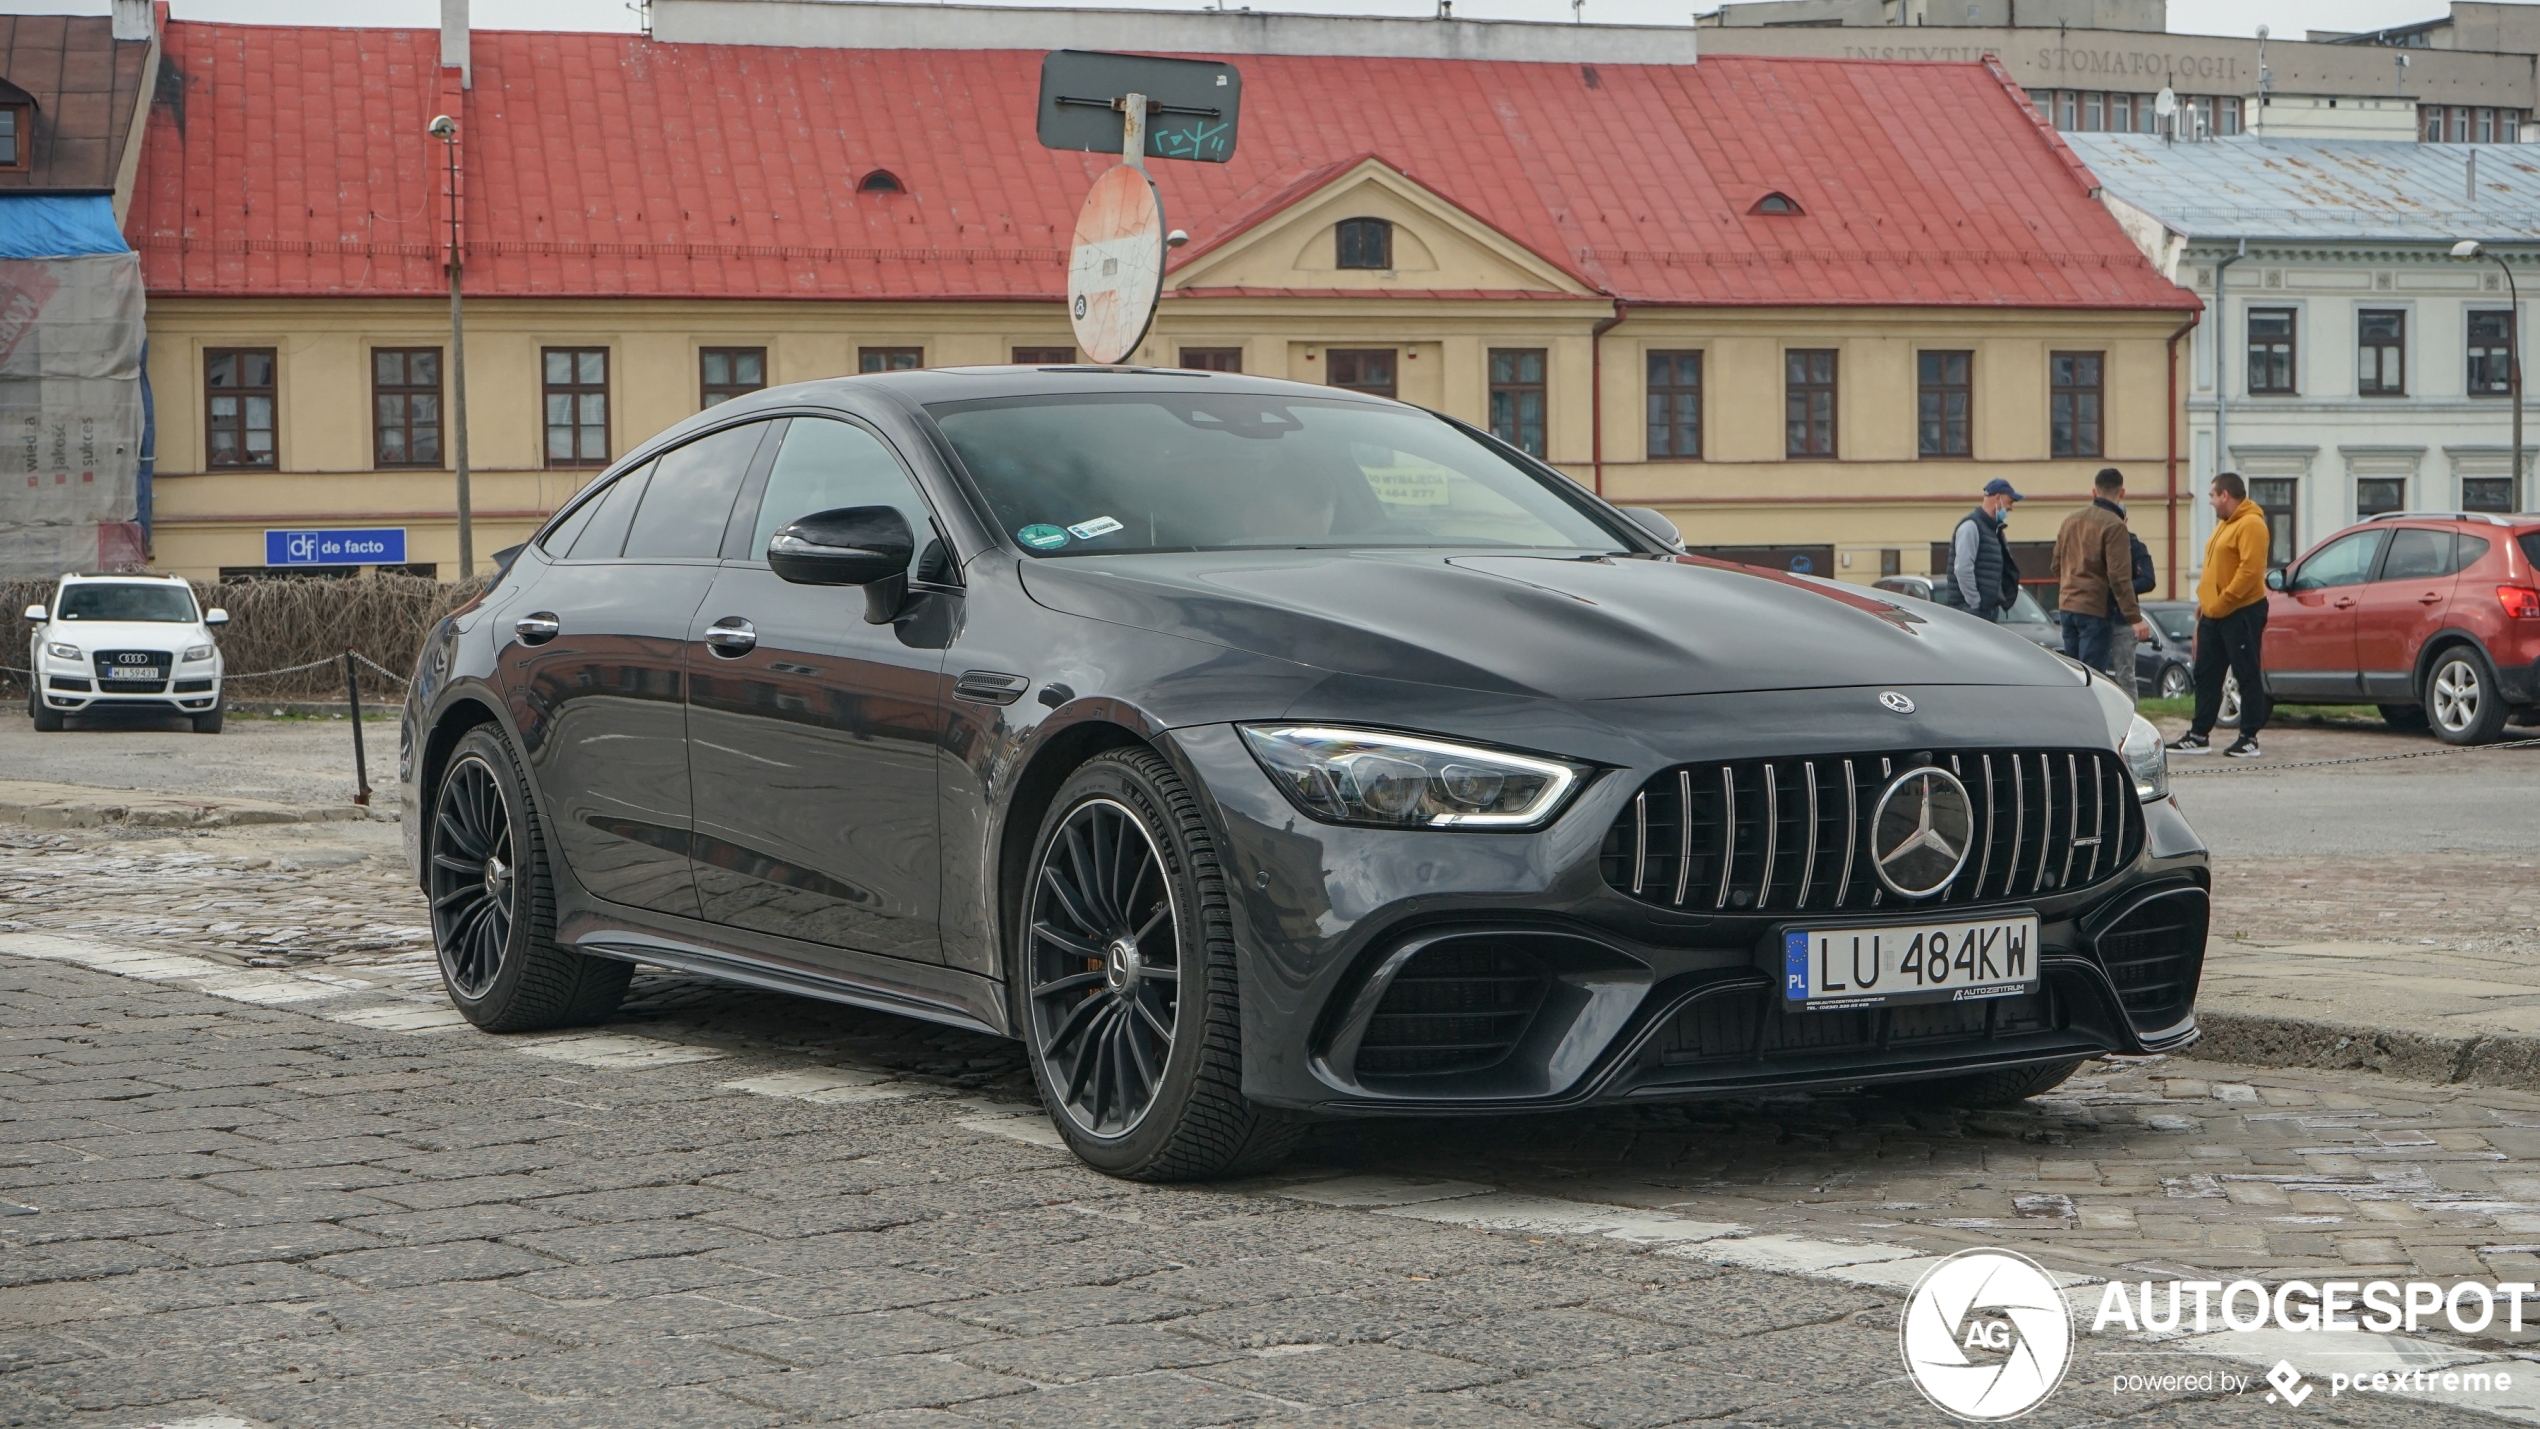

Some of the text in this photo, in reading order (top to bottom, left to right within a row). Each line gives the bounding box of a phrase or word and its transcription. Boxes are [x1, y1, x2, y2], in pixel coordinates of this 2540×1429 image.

[2038, 48, 2236, 79] STOMATOLOGII
[22, 416, 38, 473] wiedza
[79, 417, 94, 466] sukces
[321, 540, 341, 554] de
[345, 540, 384, 554] facto
[1134, 791, 1179, 869] MICHELIN
[1821, 924, 2027, 992] LU 484KW
[1788, 974, 1805, 989] PL
[1963, 983, 2025, 996] AUTOZENTRUM
